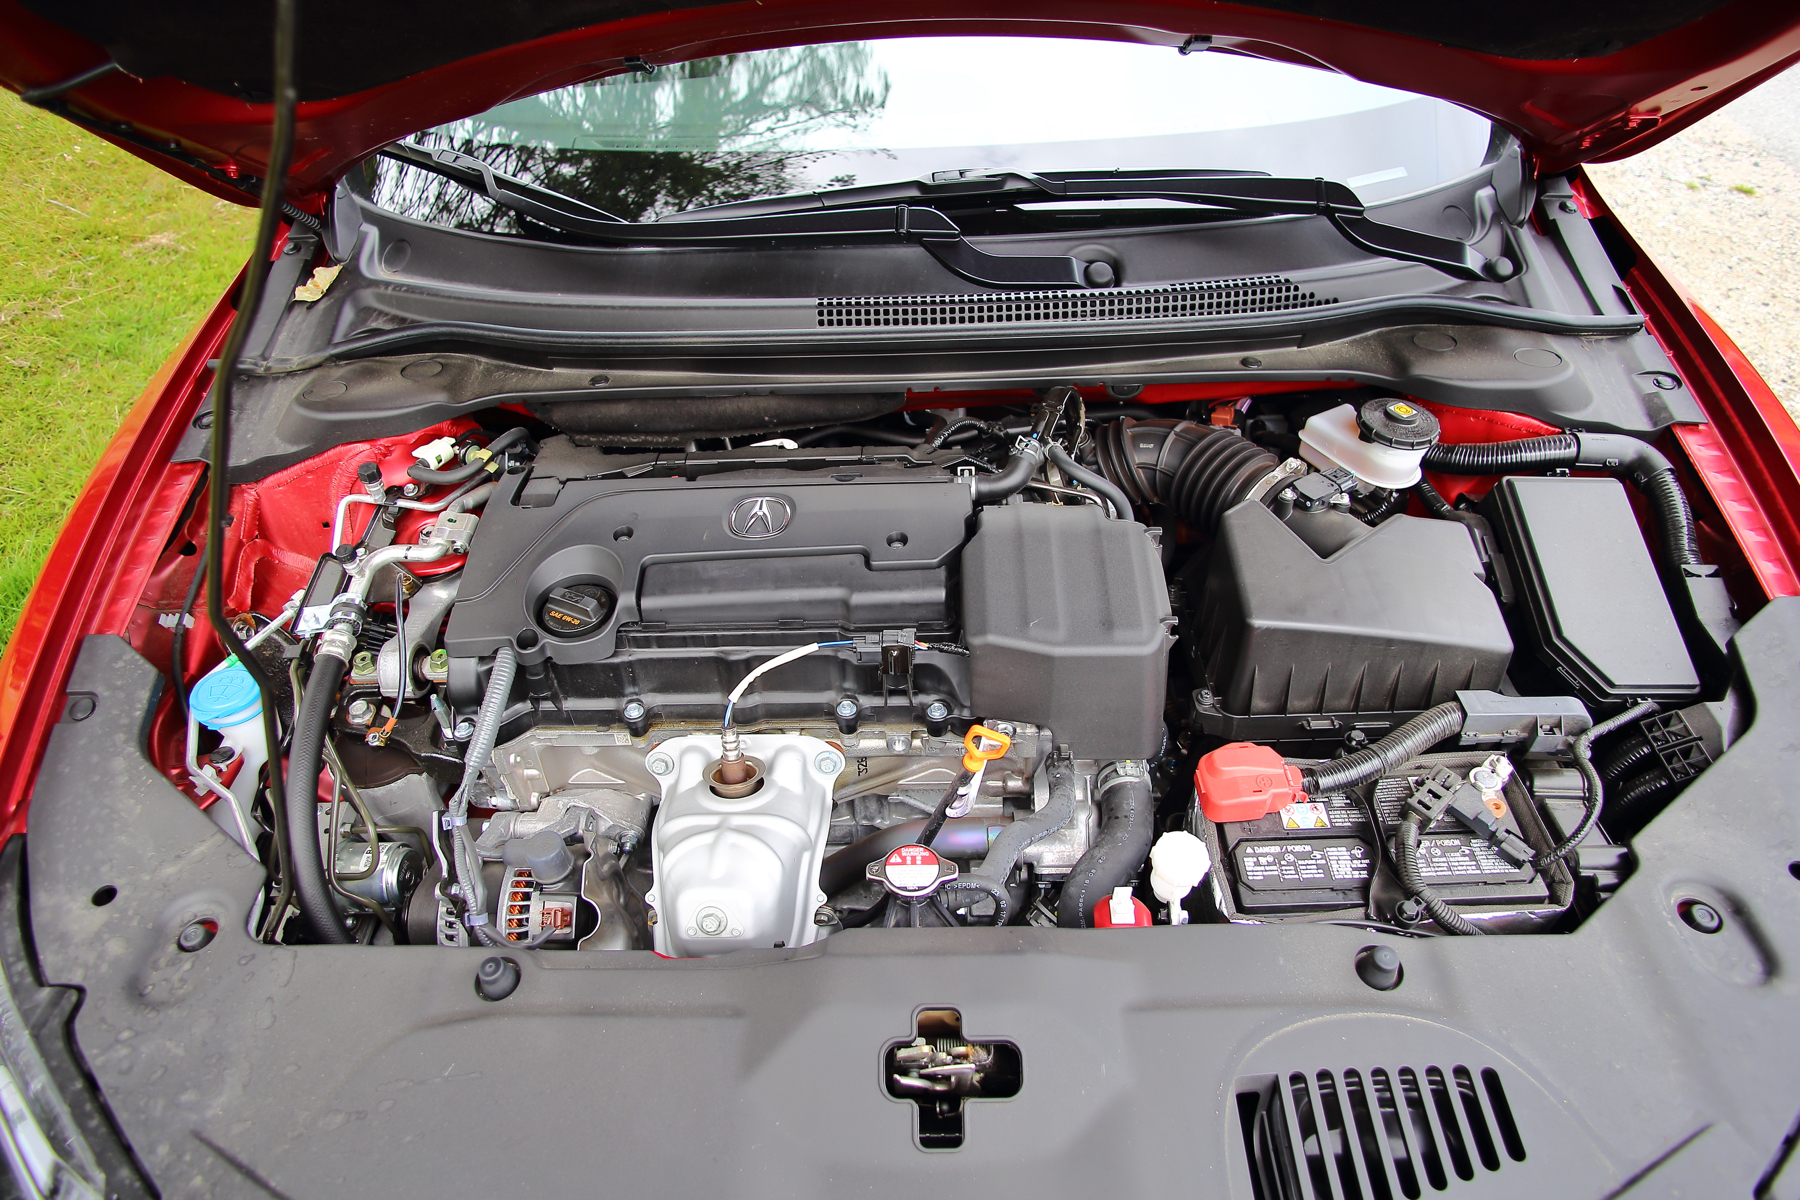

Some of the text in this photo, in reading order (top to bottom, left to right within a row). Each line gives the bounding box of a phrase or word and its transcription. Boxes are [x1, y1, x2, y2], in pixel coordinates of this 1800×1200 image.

[549, 610, 581, 625] SAE 0W-20
[856, 756, 868, 777] 326
[1254, 845, 1281, 854] DANGER
[1287, 844, 1312, 853] POISON
[999, 900, 1007, 908] 02
